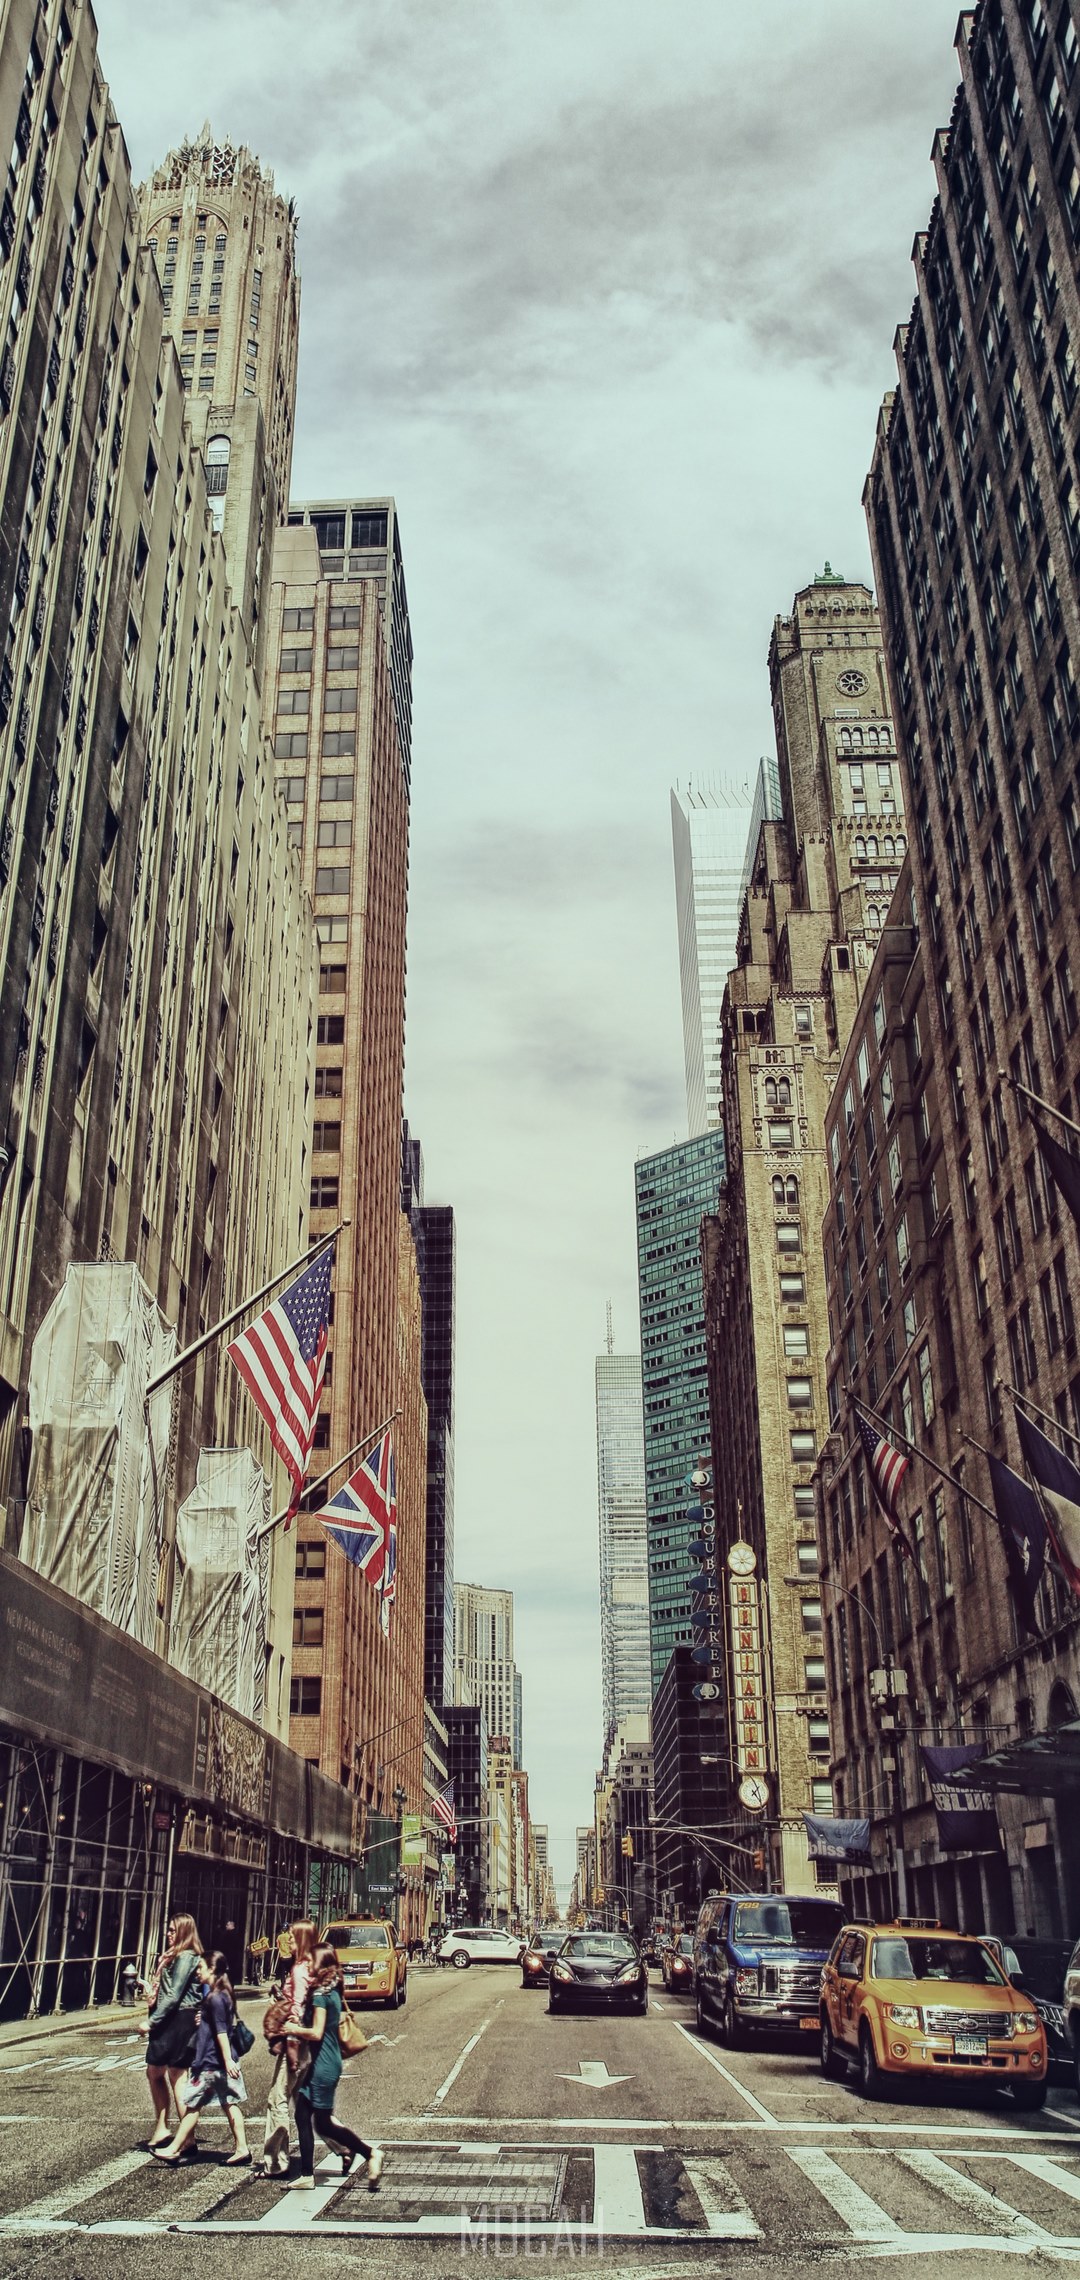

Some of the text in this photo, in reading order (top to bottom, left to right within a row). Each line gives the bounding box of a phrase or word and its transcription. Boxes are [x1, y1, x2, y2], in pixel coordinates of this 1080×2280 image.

[702, 1506, 721, 1678] DOUBLETREE
[740, 1587, 757, 1766] BENJAMIN
[808, 1840, 846, 1857] bliss
